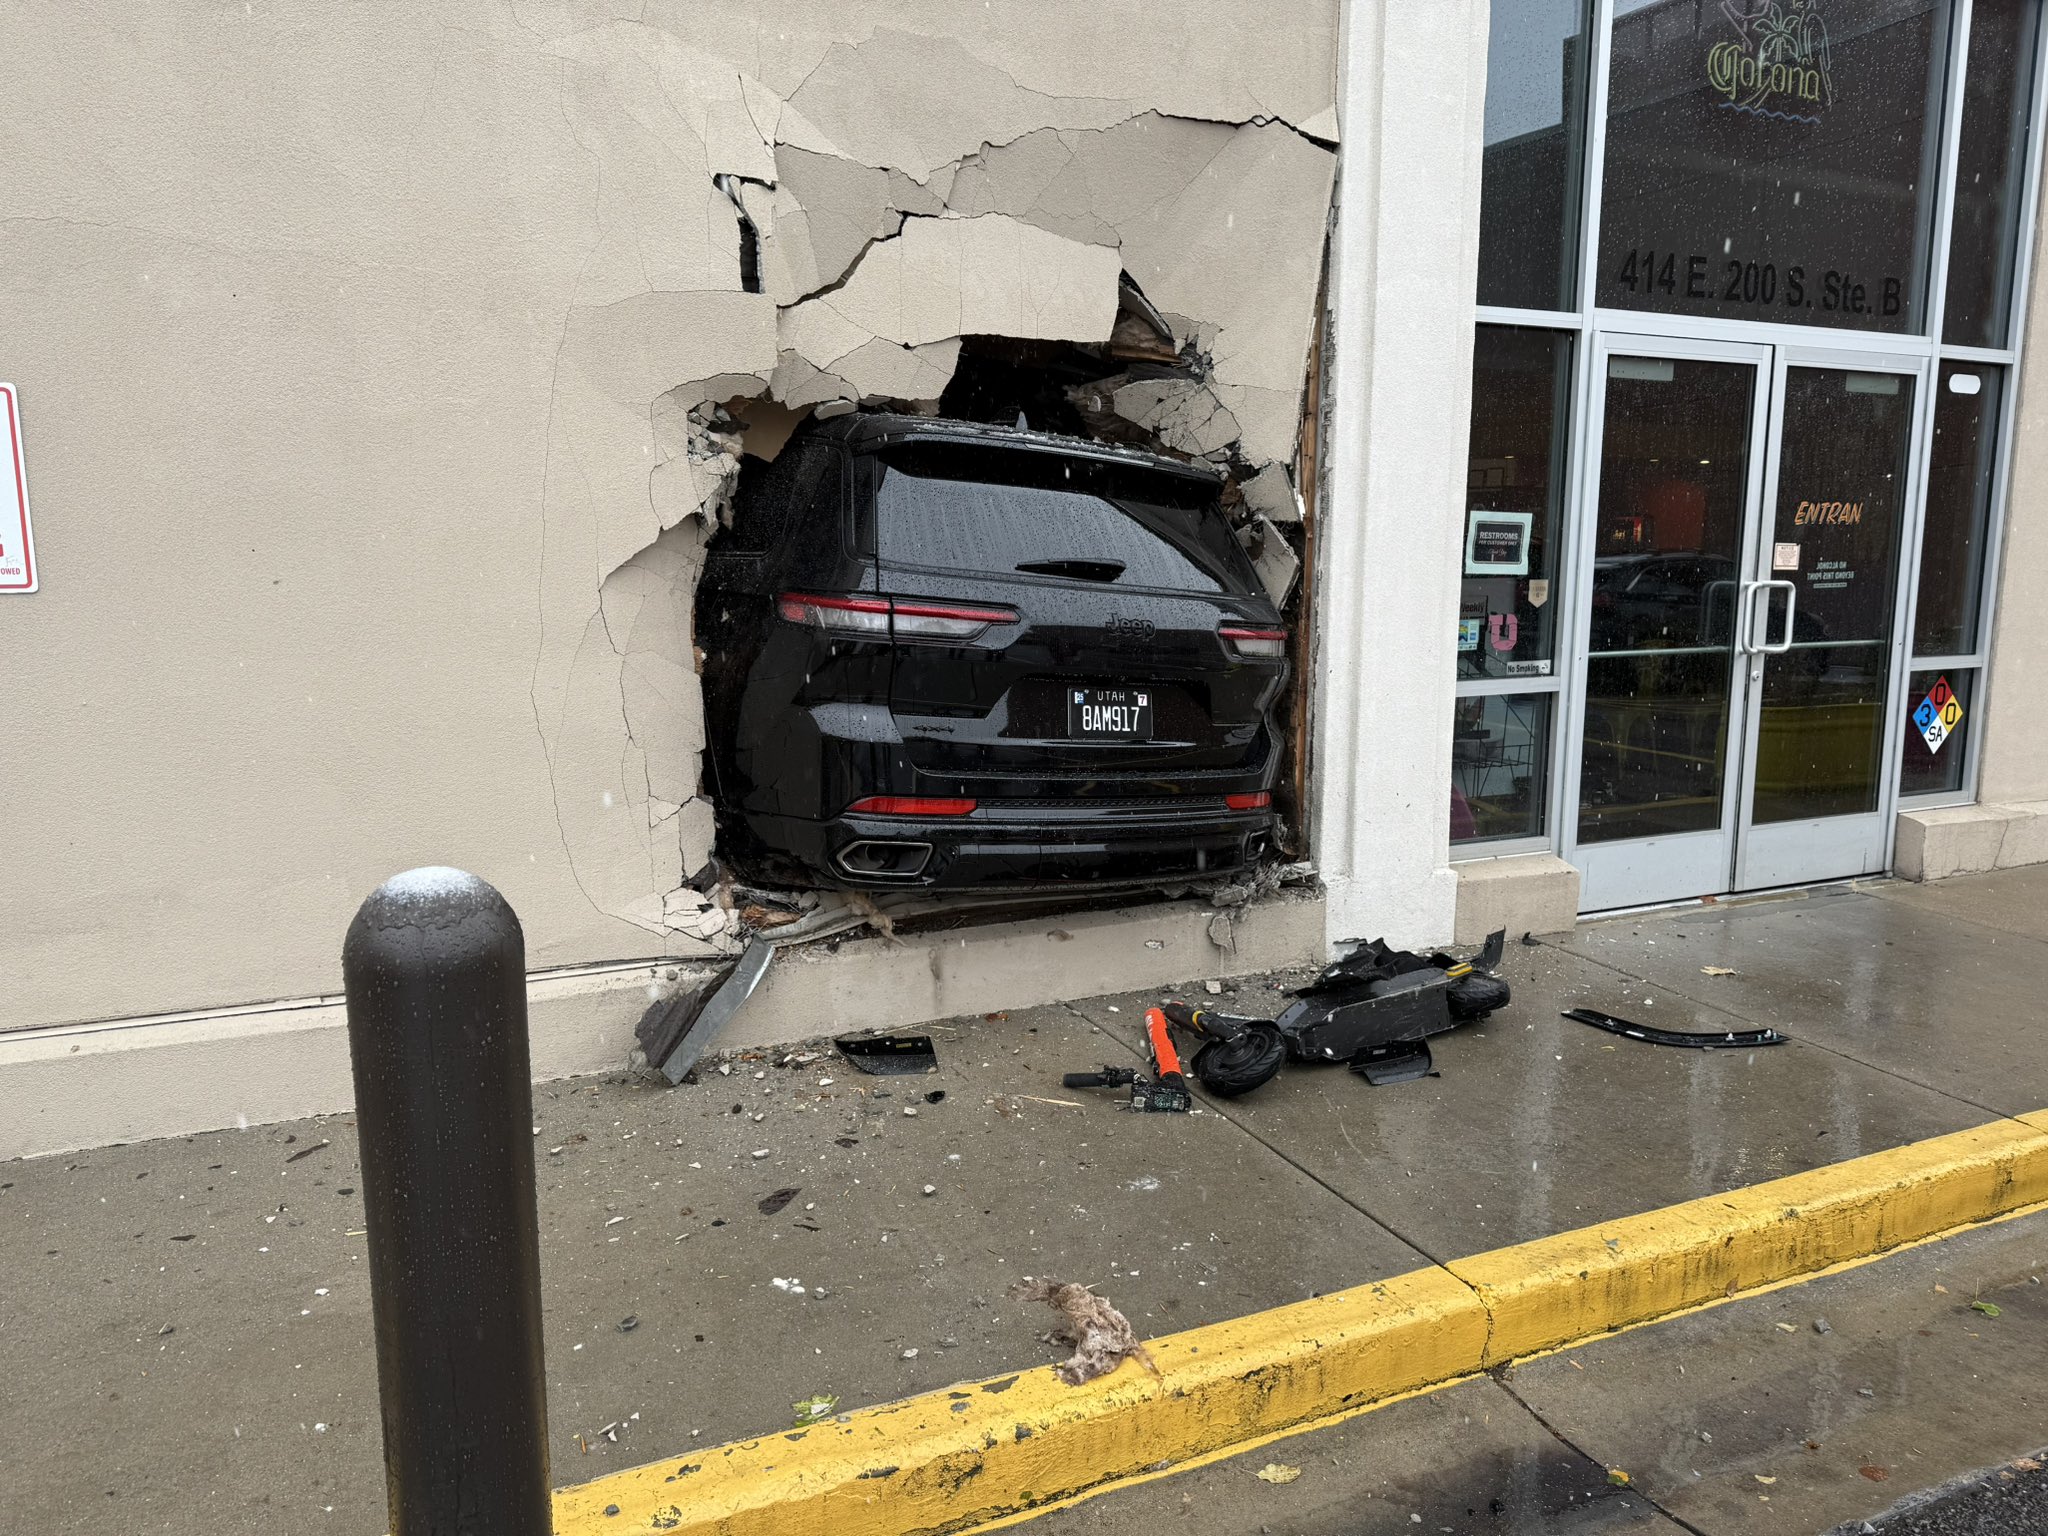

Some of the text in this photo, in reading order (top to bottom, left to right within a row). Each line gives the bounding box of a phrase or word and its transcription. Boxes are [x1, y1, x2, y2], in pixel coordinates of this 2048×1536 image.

[1708, 42, 1819, 101] Corona
[1620, 249, 1901, 316] 414 E. 200 S. Ste. B
[1794, 501, 1863, 525] ENTRAN
[1479, 531, 1518, 540] RESTROOMS
[1105, 613, 1156, 638] Jeep
[1507, 664, 1539, 674] No Smoking
[1076, 693, 1084, 701] 25
[1097, 691, 1125, 702] UTAH
[1139, 695, 1146, 704] 7
[1935, 683, 1946, 705] 0
[1082, 705, 1140, 731] 8AM917
[1919, 704, 1931, 727] 3
[1945, 702, 1956, 725] 0
[1928, 726, 1942, 742] SA
